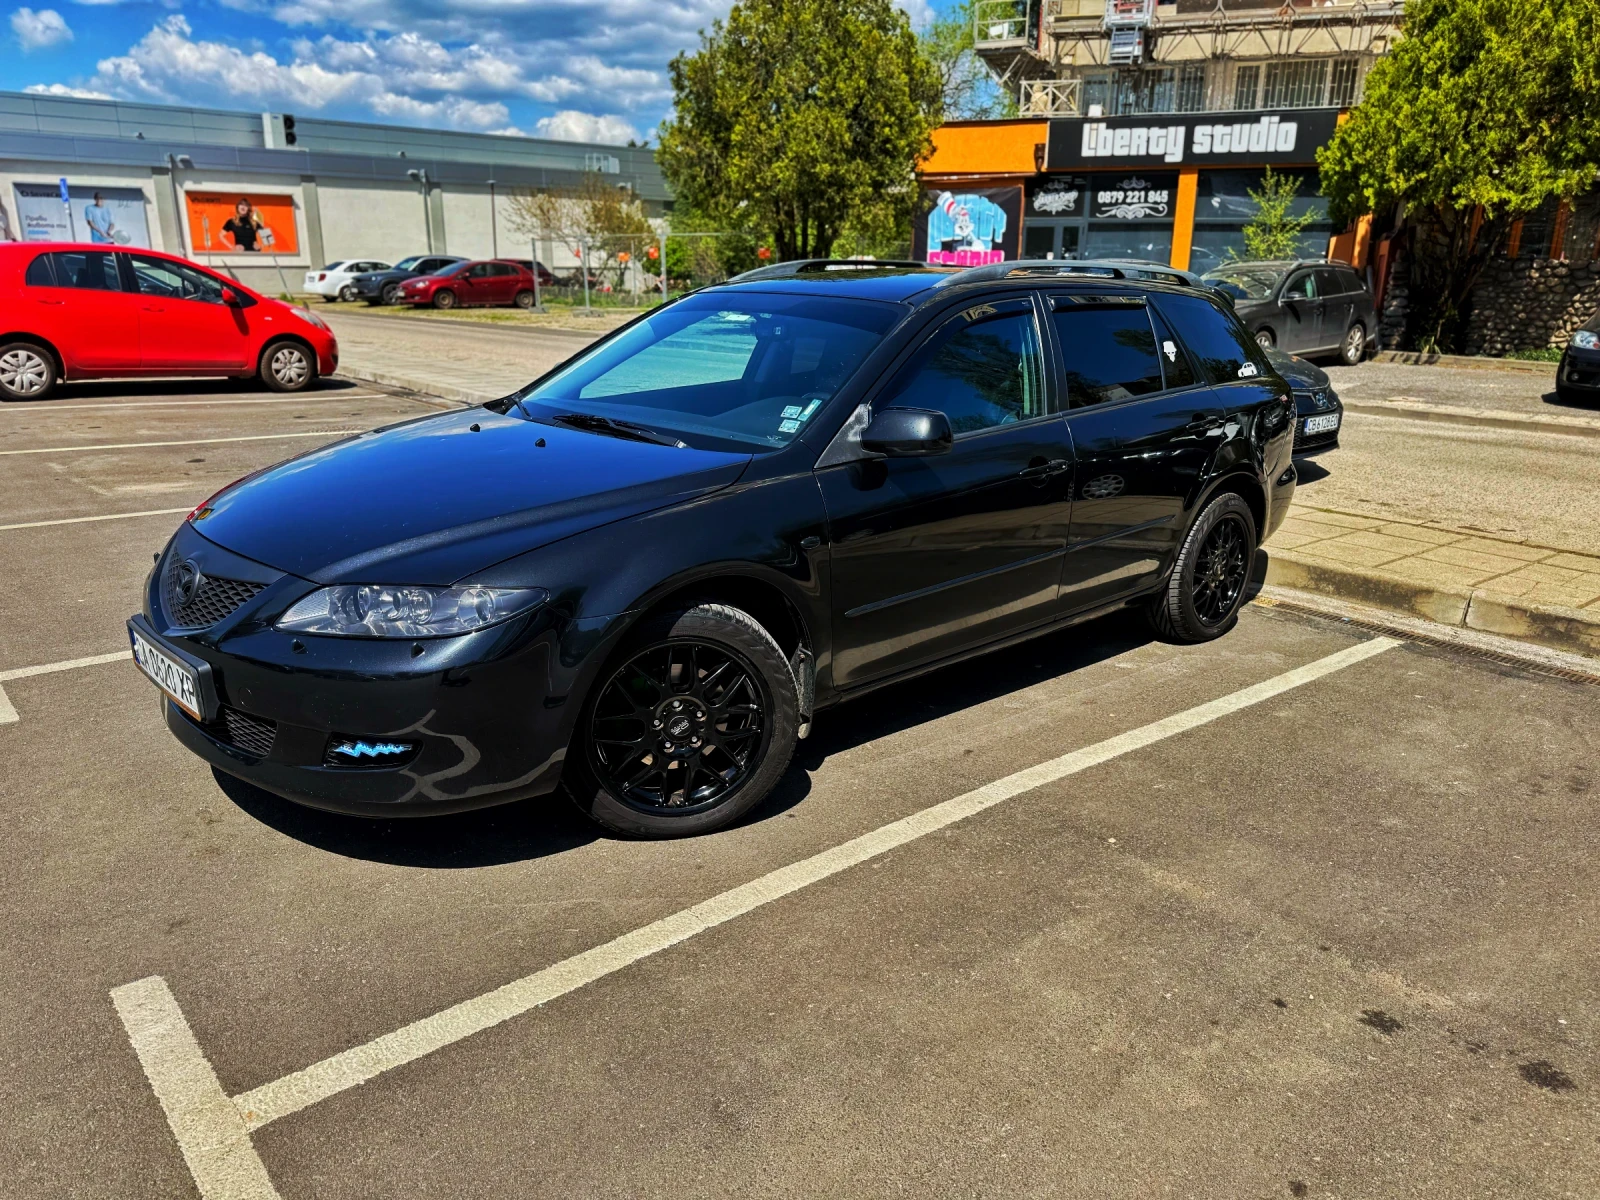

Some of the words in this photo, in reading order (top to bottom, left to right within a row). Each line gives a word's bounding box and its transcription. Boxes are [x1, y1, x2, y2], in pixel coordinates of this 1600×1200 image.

[1192, 116, 1298, 154] studio
[1097, 190, 1124, 204] 0879
[1125, 190, 1145, 203] 221
[1147, 190, 1169, 203] 845
